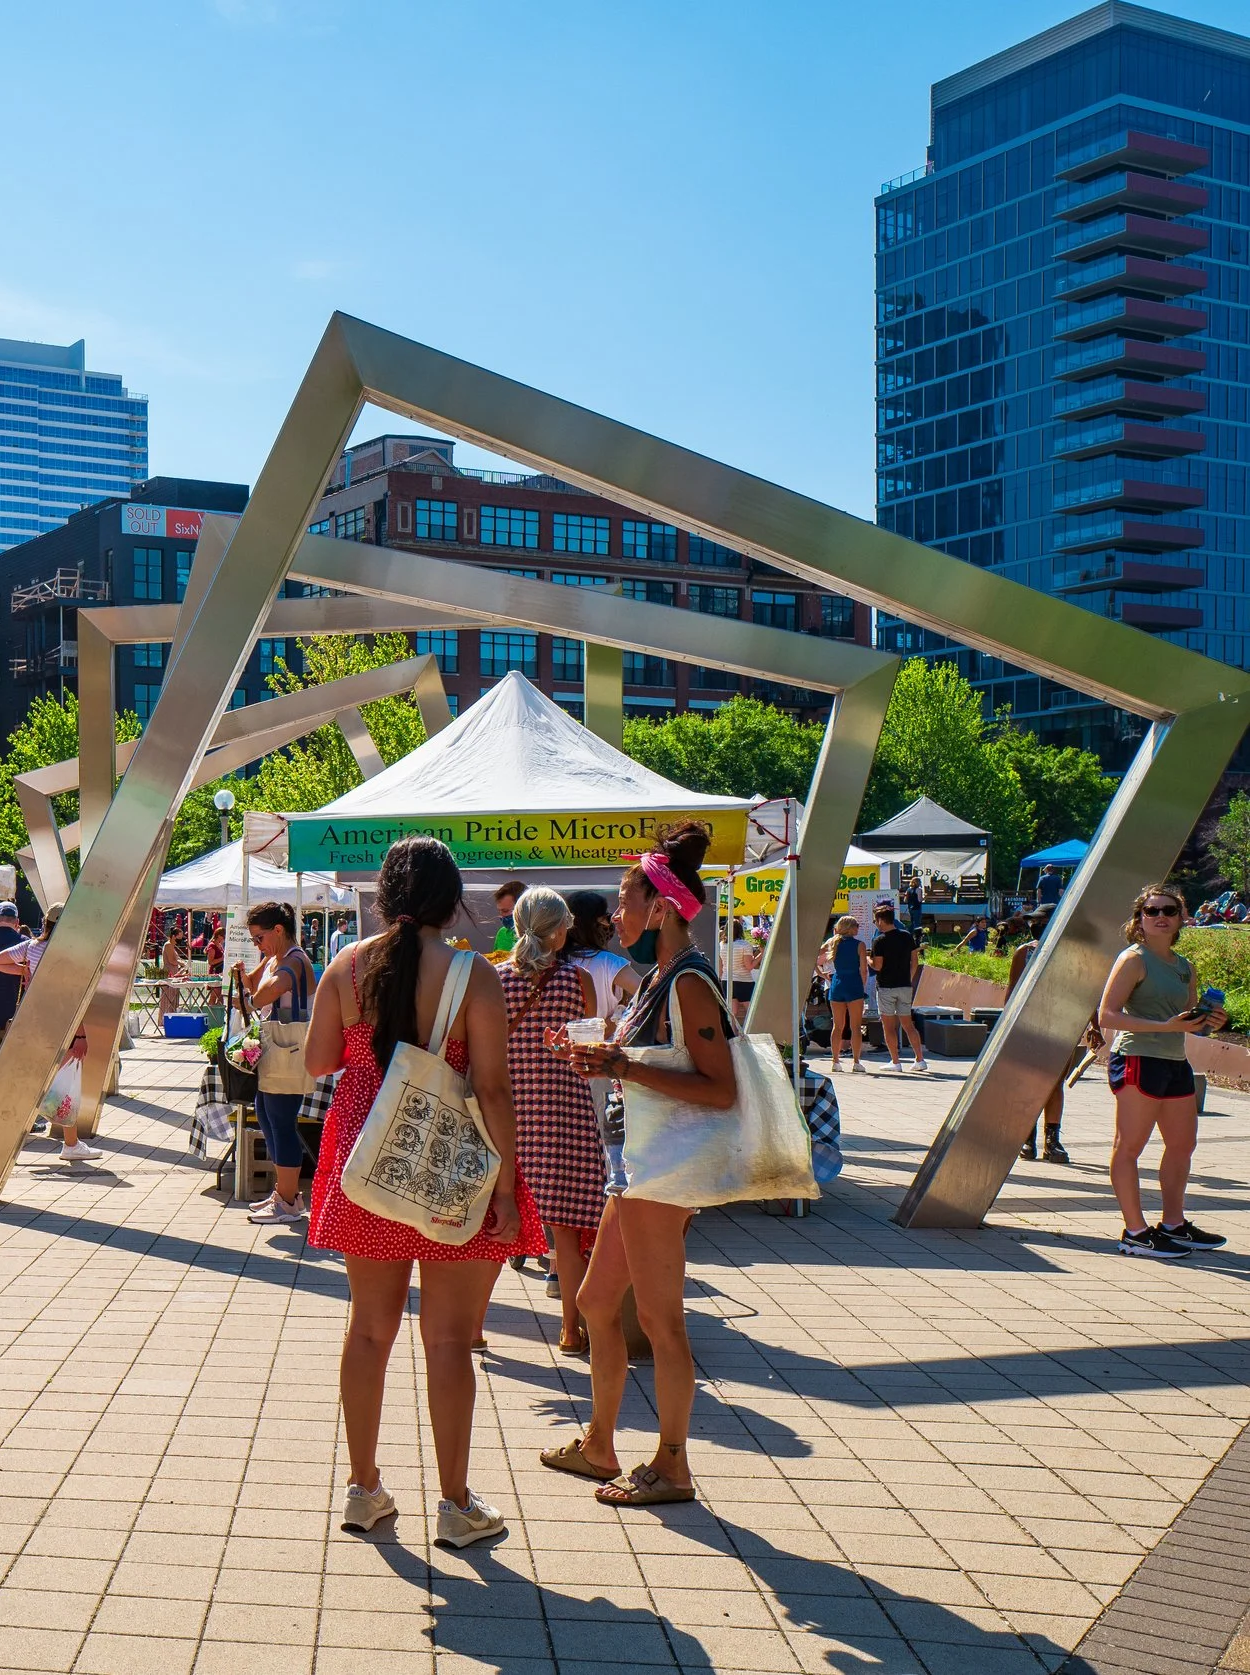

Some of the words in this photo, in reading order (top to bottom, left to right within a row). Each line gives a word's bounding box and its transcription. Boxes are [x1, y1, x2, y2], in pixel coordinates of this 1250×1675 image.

[127, 507, 161, 520] SOLD
[131, 521, 158, 534] OUT
[175, 523, 201, 535] SixN
[464, 819, 538, 843] Pride
[329, 850, 374, 864] Fresh
[528, 846, 544, 860] &
[746, 876, 784, 893] Gras
[838, 873, 876, 889] Beef
